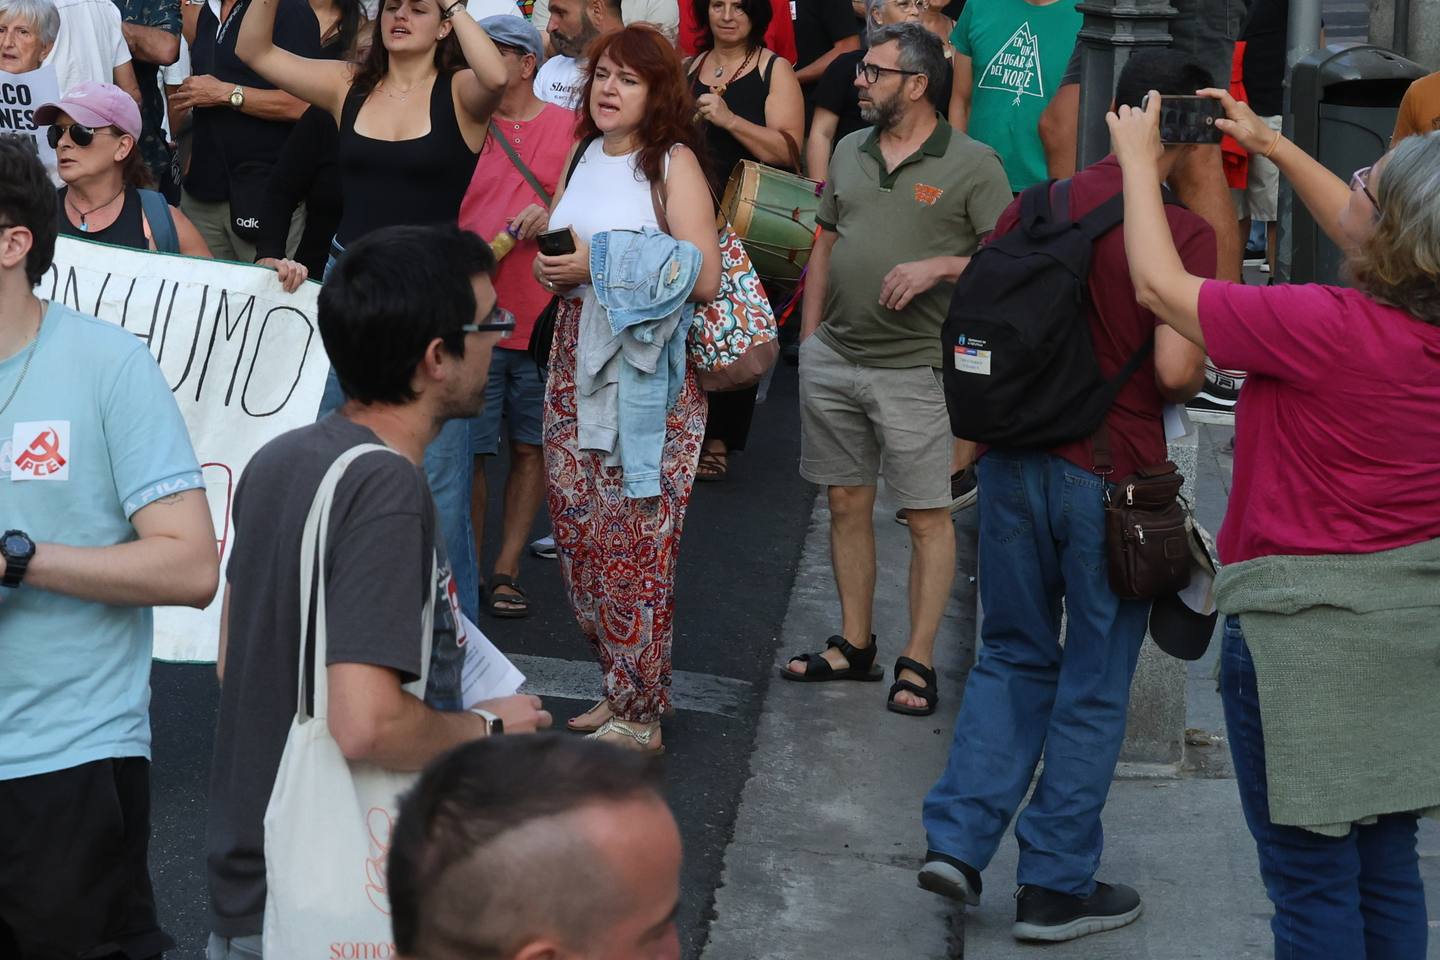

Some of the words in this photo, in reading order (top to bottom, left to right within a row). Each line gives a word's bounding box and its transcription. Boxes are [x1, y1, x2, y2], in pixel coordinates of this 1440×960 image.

[1013, 37, 1023, 48] EN
[1020, 45, 1032, 55] UN
[998, 53, 1025, 68] LUGAR
[990, 65, 1003, 76] DEL
[1001, 69, 1034, 88] NORTE
[121, 278, 315, 418] HUMO
[20, 460, 60, 476] PCE
[140, 478, 189, 503] FILA
